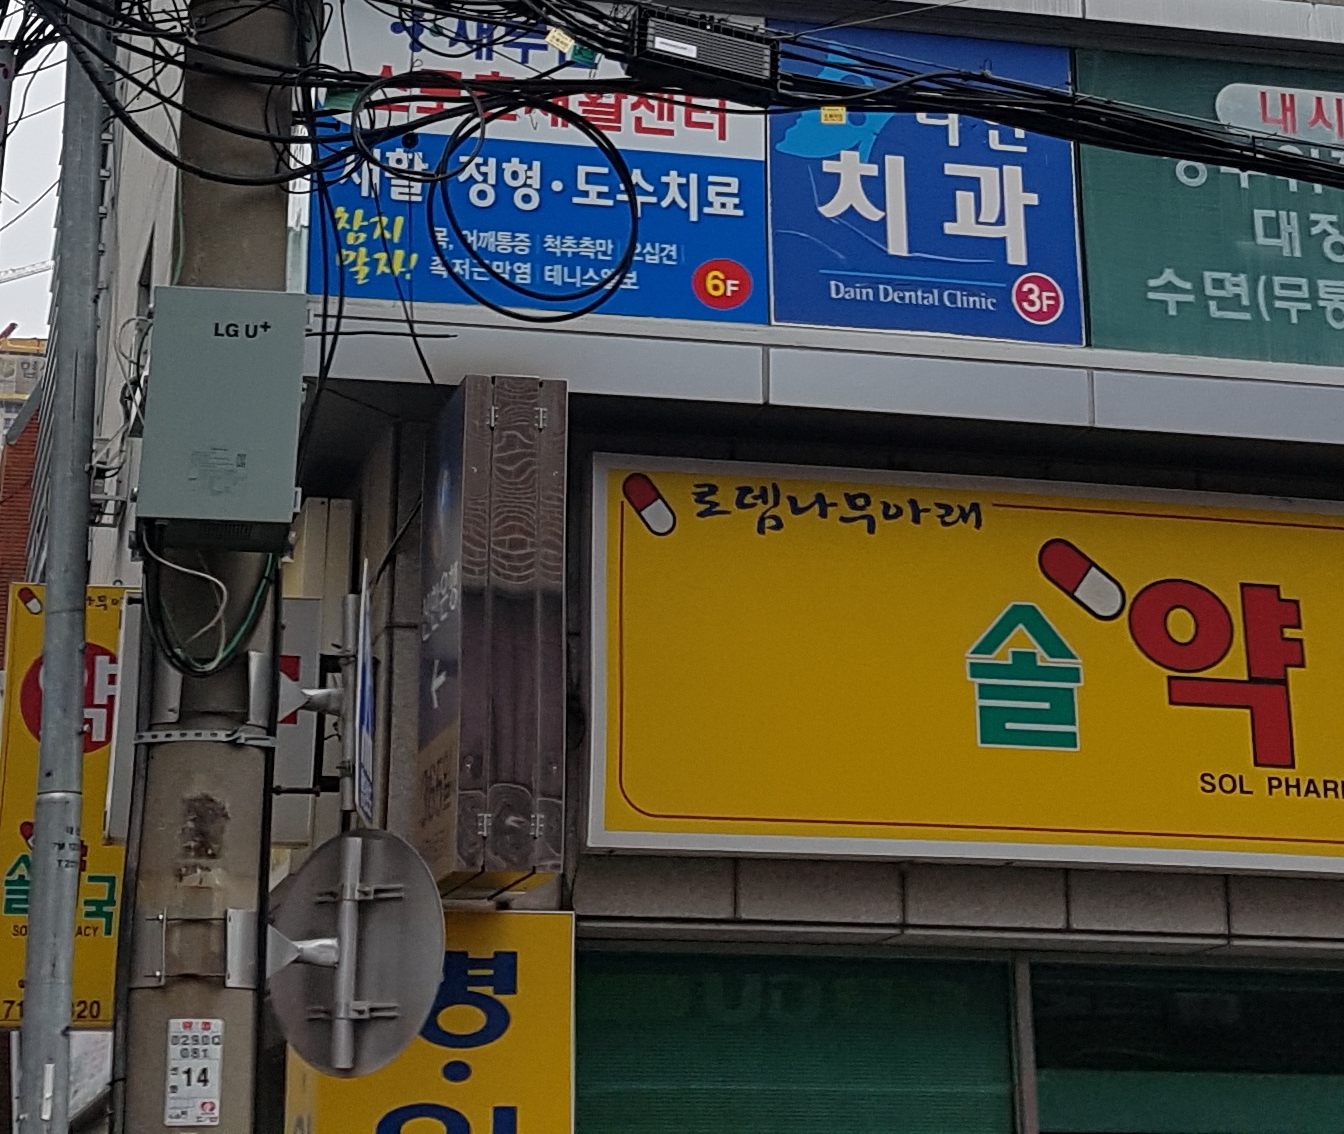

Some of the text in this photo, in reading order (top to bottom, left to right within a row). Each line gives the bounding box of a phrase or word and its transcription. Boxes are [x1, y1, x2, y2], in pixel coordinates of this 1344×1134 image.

[817, 150, 1040, 267] 치과
[542, 234, 615, 262] 척추측만
[705, 270, 741, 297] 6F
[829, 280, 997, 311] Dain Dental Clinic
[1021, 283, 1057, 313] 3F
[213, 322, 240, 338] LG
[1199, 772, 1254, 795] SOL
[182, 1067, 210, 1087] 14
